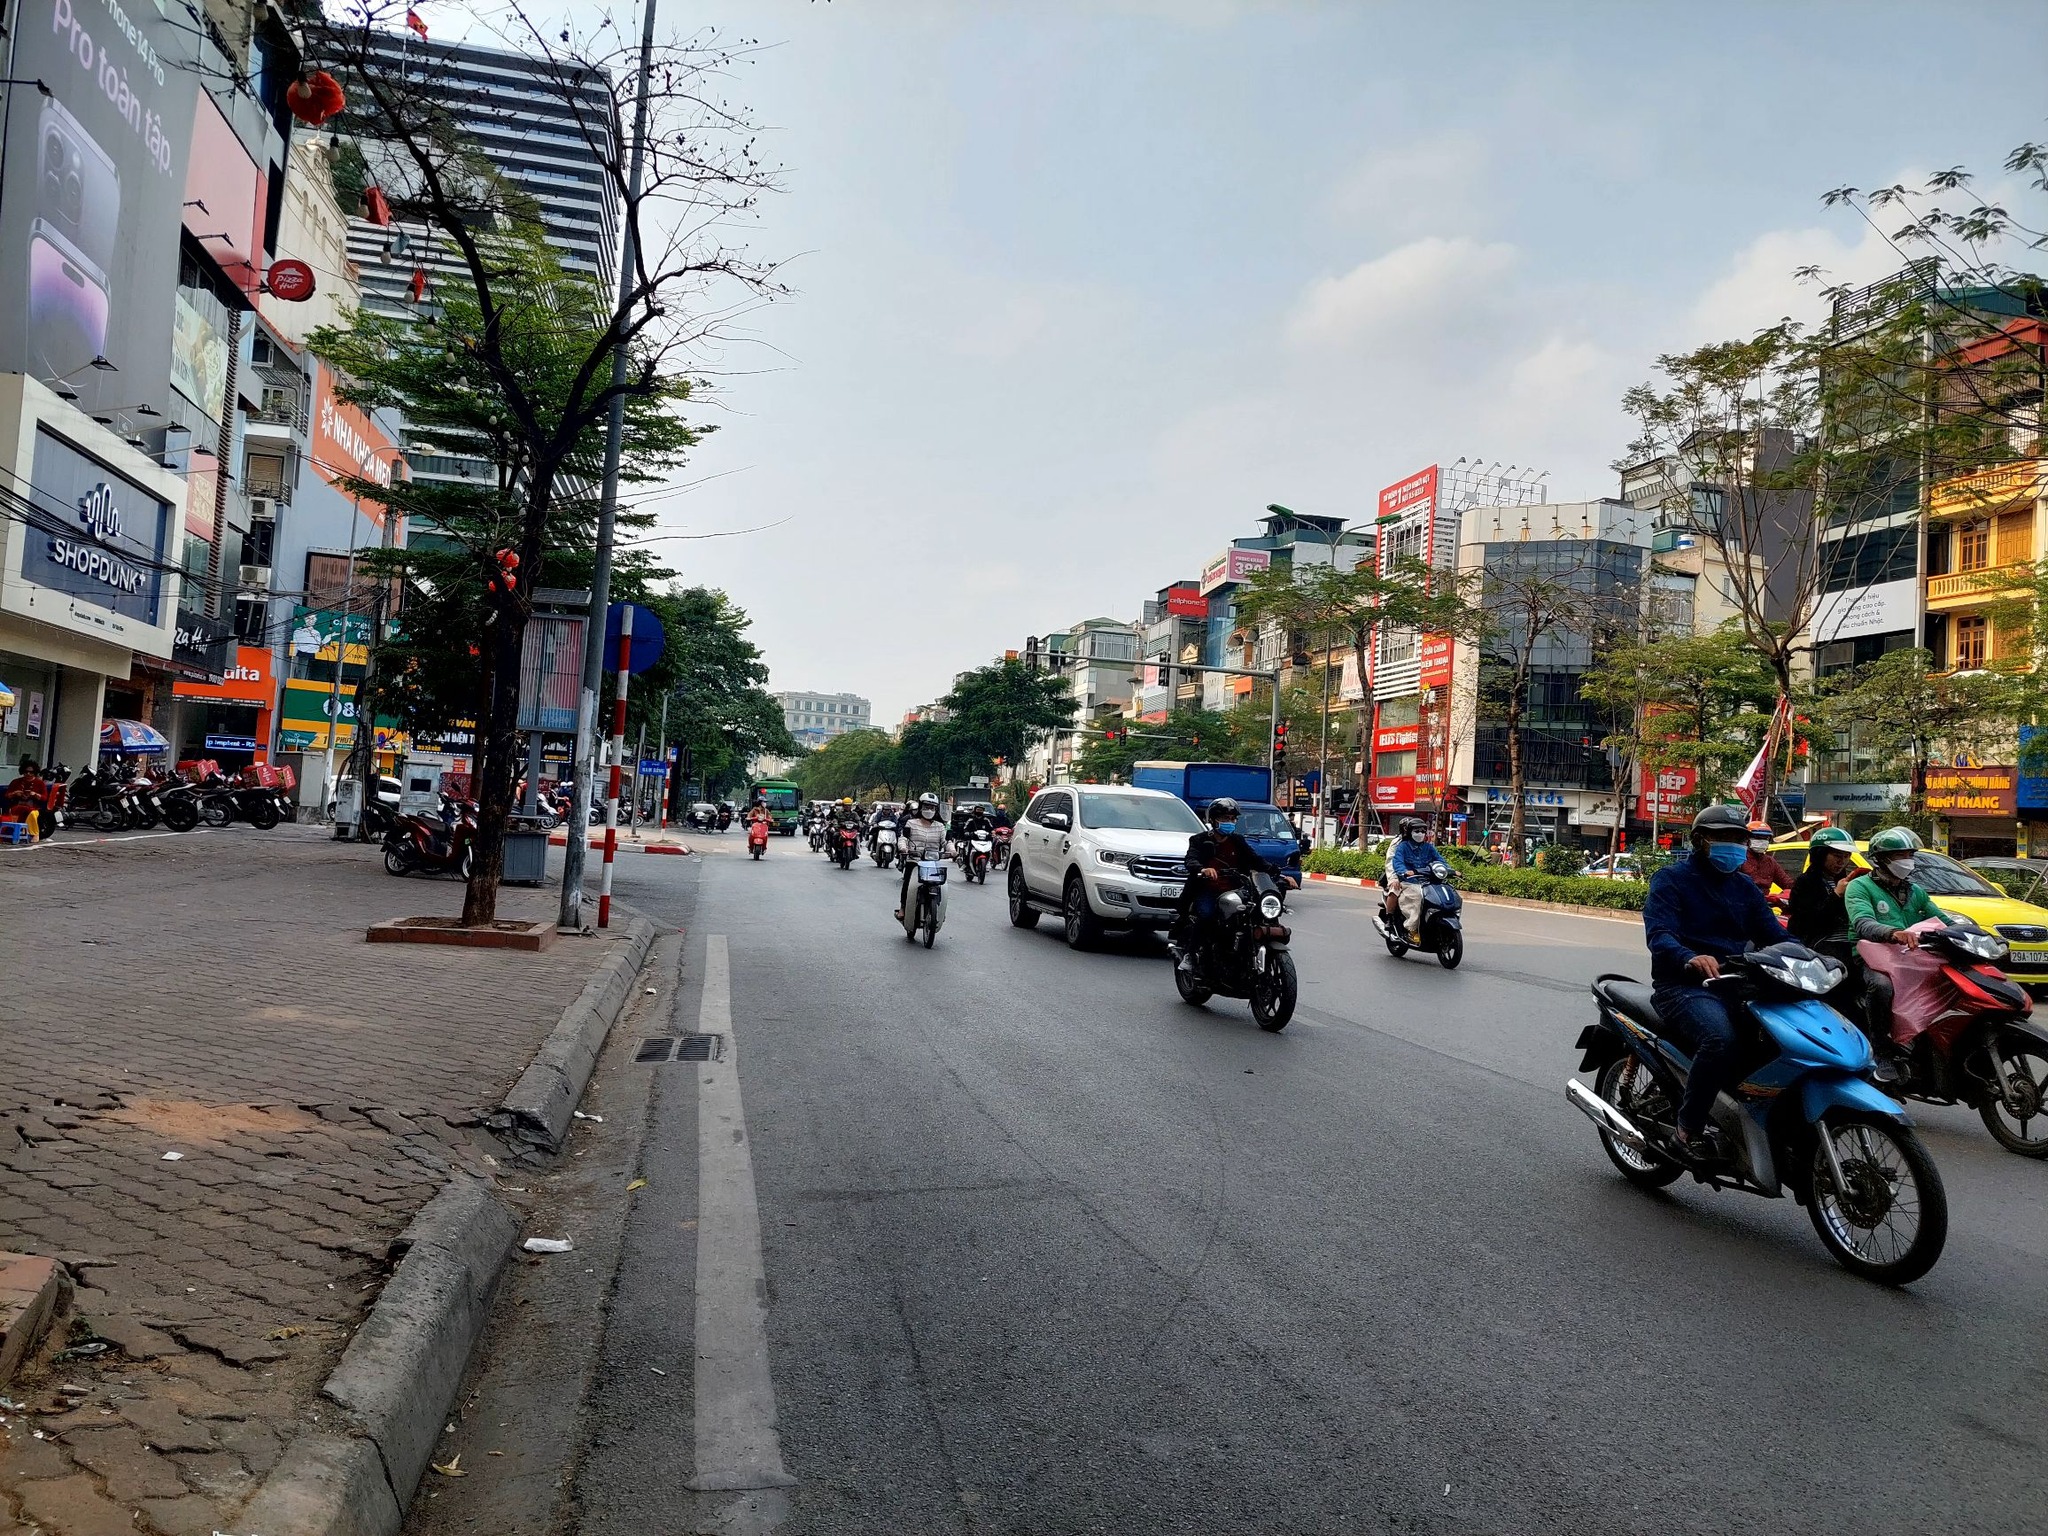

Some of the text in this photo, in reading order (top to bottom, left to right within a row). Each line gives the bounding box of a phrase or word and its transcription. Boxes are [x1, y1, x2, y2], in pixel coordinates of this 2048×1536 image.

[53, 0, 93, 70] Pro
[98, 47, 141, 134] toàn
[279, 282, 298, 290] Hut
[333, 411, 352, 456] NHA
[1957, 795, 2000, 809] KHANG
